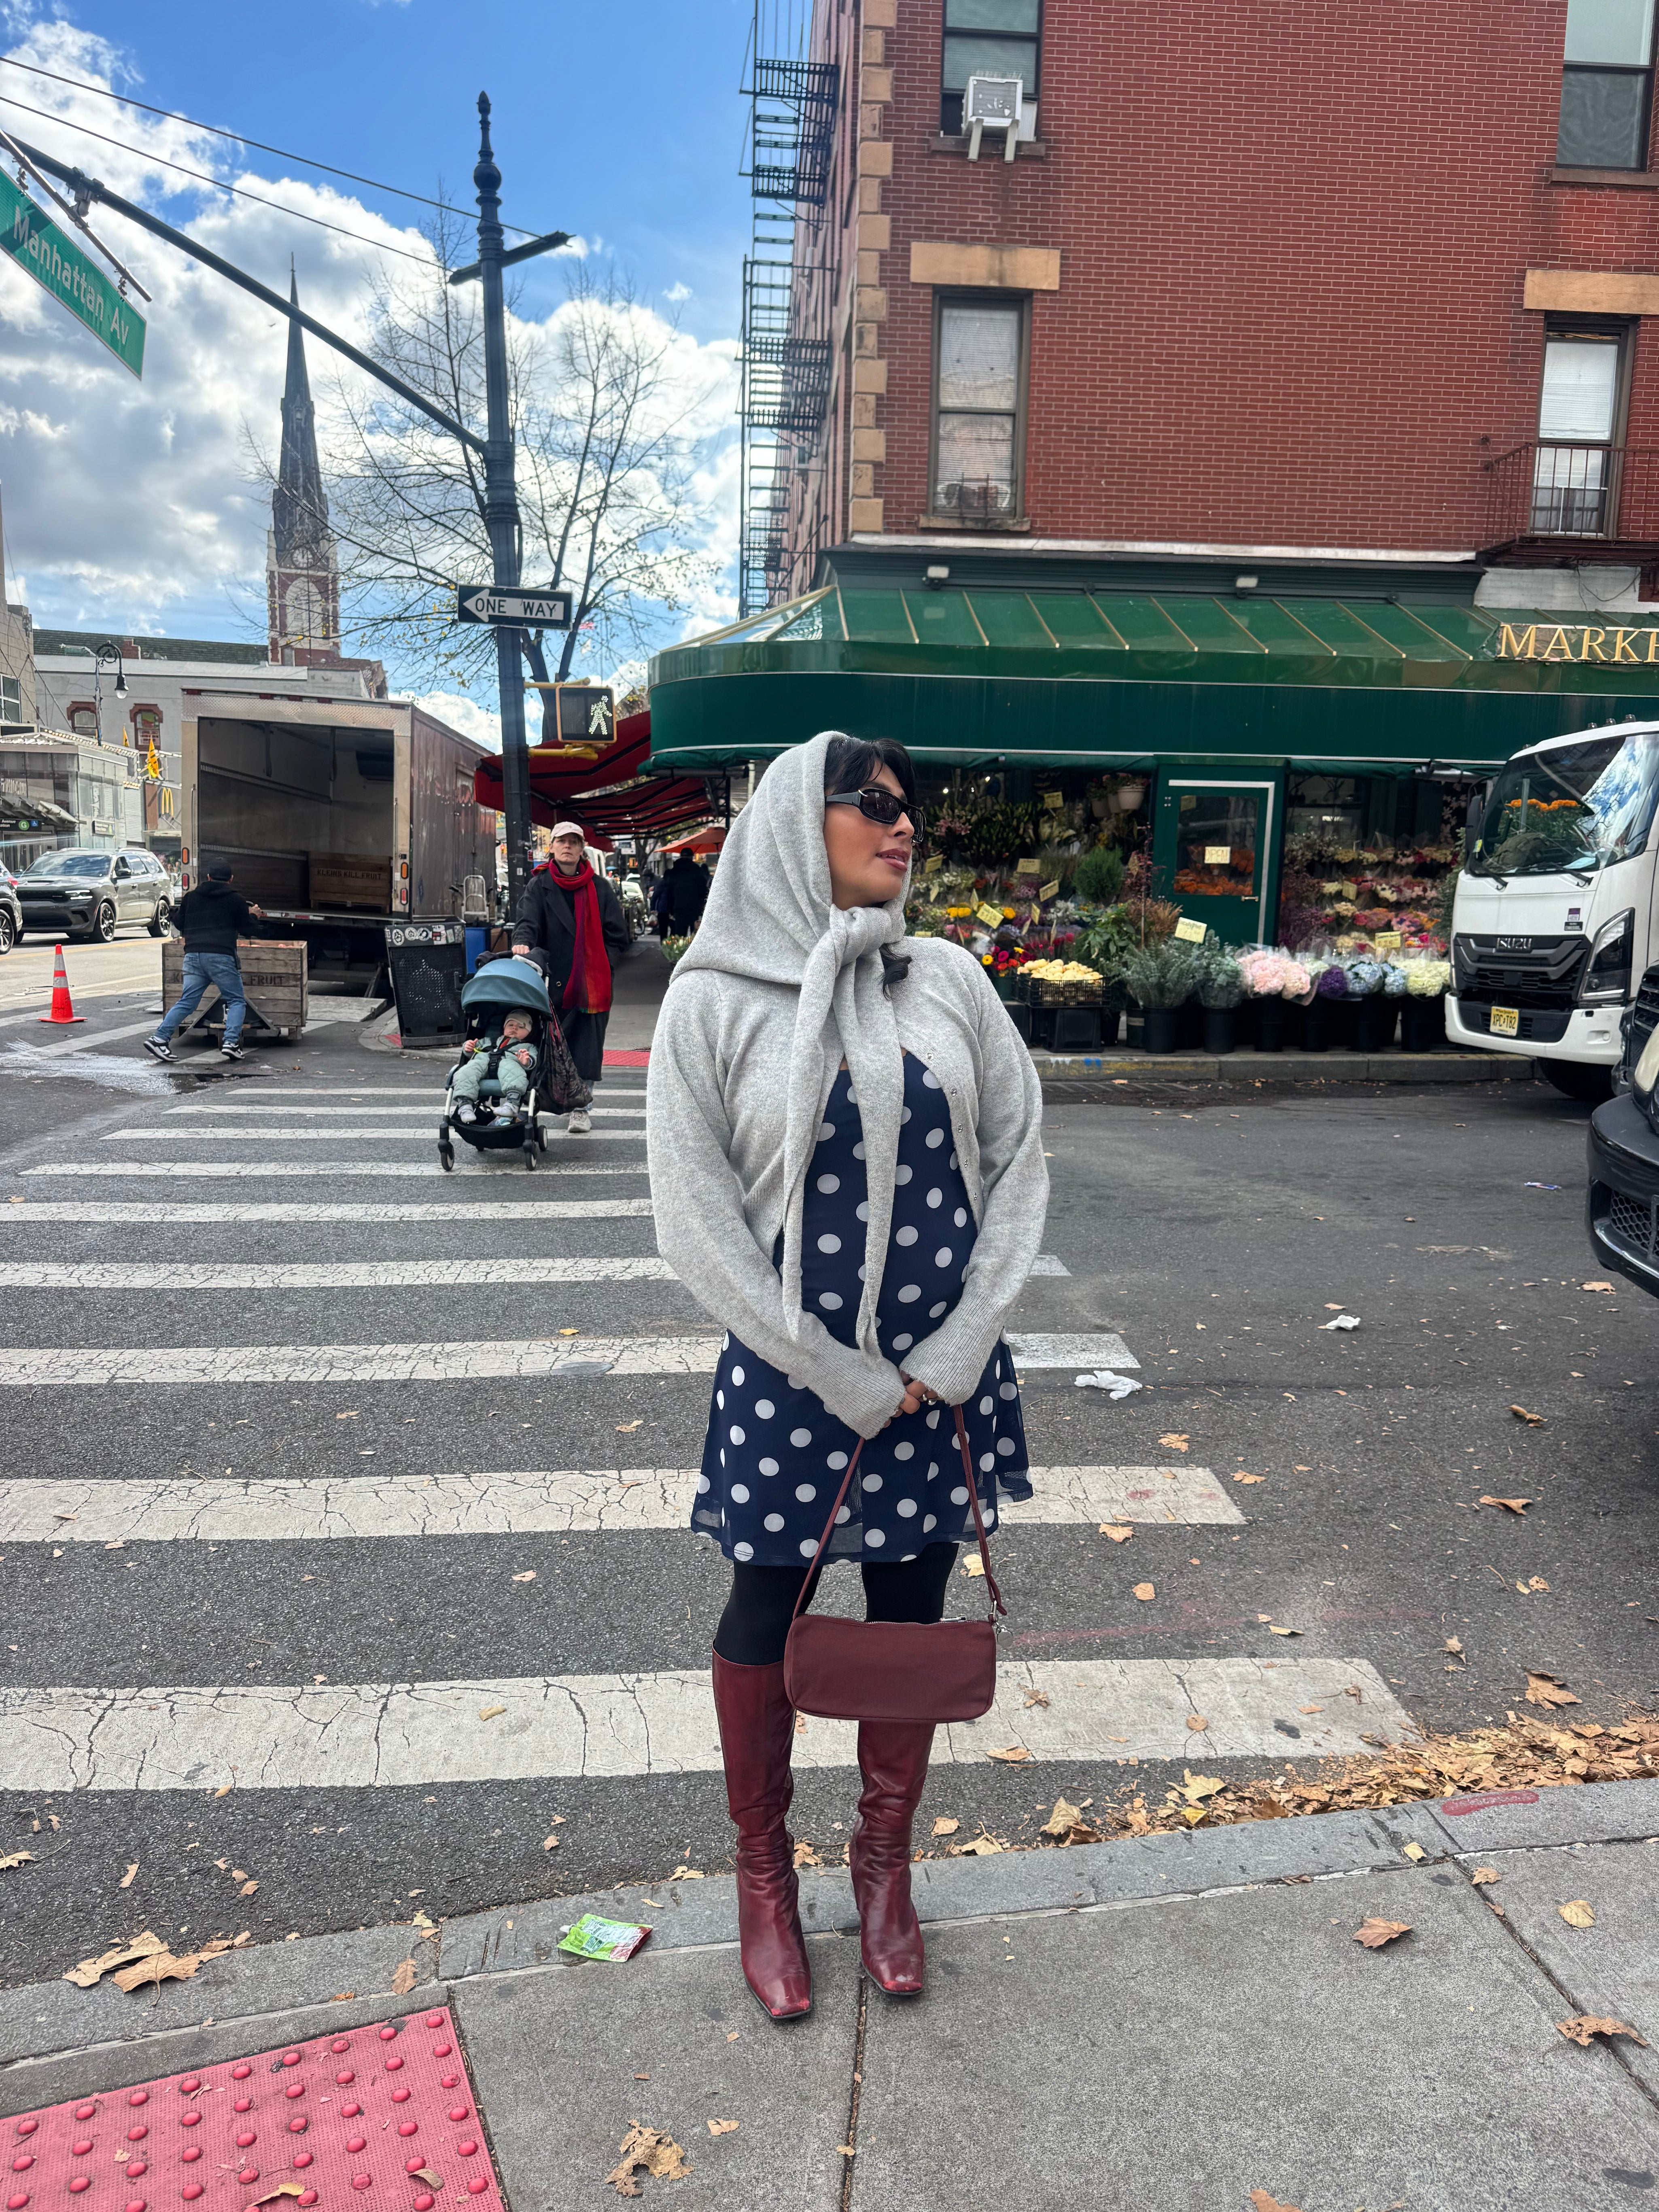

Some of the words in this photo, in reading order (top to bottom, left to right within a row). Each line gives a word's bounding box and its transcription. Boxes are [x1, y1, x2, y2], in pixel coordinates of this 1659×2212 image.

[13, 206, 104, 321] Manhattan
[110, 307, 129, 344] Av
[475, 598, 507, 614] ONE
[523, 601, 557, 618] WAY
[361, 872, 382, 881] FRUIT
[250, 974, 286, 985] FRUIT
